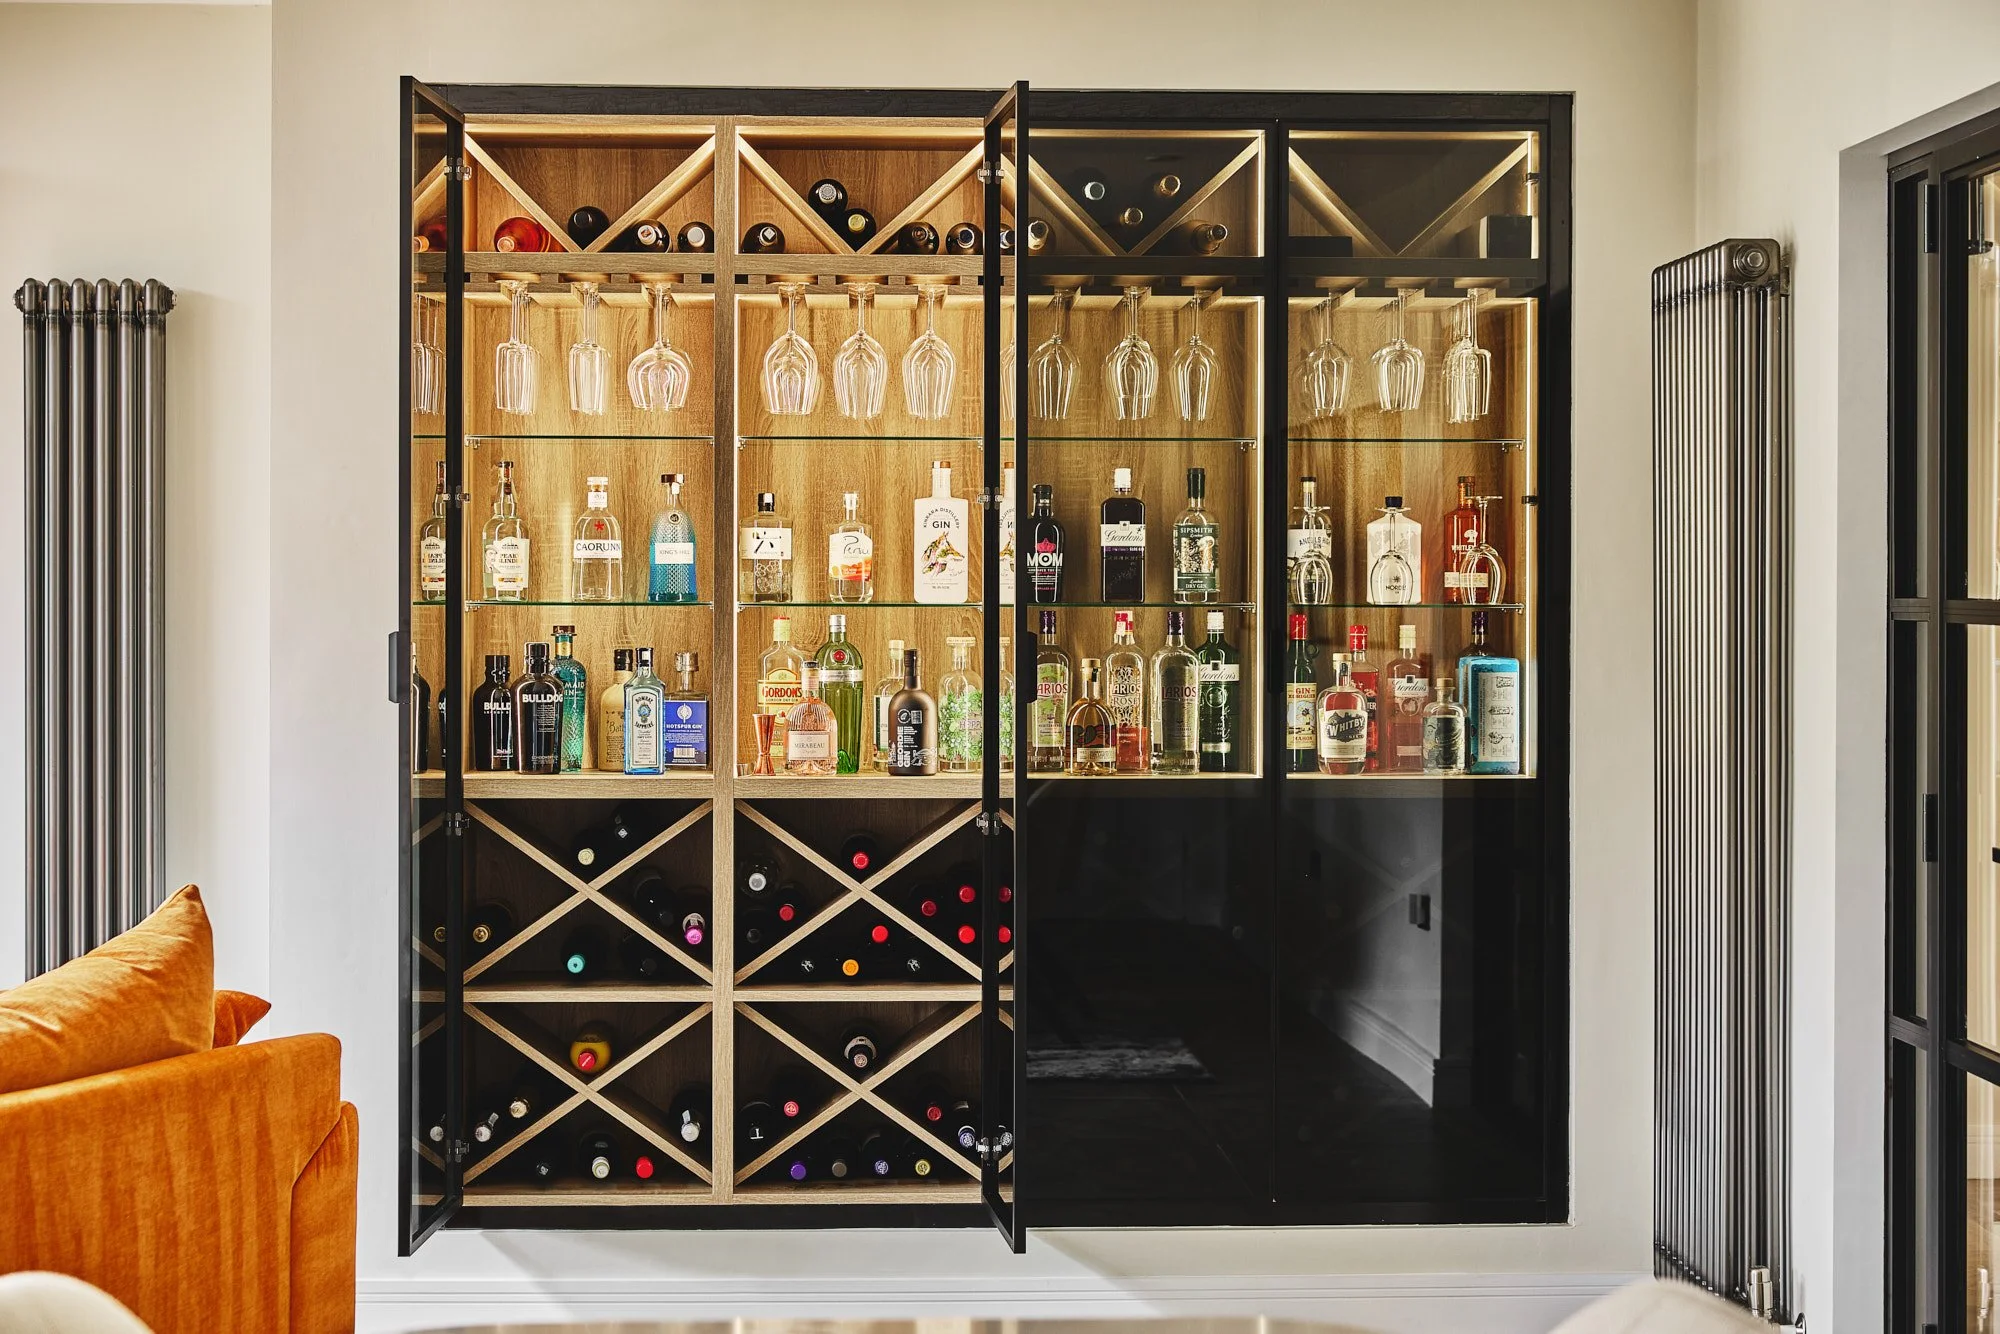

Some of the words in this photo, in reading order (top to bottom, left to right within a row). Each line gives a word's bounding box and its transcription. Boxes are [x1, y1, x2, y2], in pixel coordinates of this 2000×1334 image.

[932, 520, 951, 529] GIN
[1104, 529, 1144, 543] Gordon's
[575, 542, 621, 552] CAORUNN
[1026, 552, 1063, 567] MOM
[762, 685, 802, 698] GORDON'S
[1036, 683, 1068, 694] ARIOS
[1161, 686, 1197, 698] LARIOS
[522, 693, 564, 703] BULLDOG
[634, 695, 654, 705] BOMBAY
[483, 701, 511, 711] BULLD
[634, 720, 655, 729] SAPPHIRE
[1327, 718, 1365, 737] WHITBY
